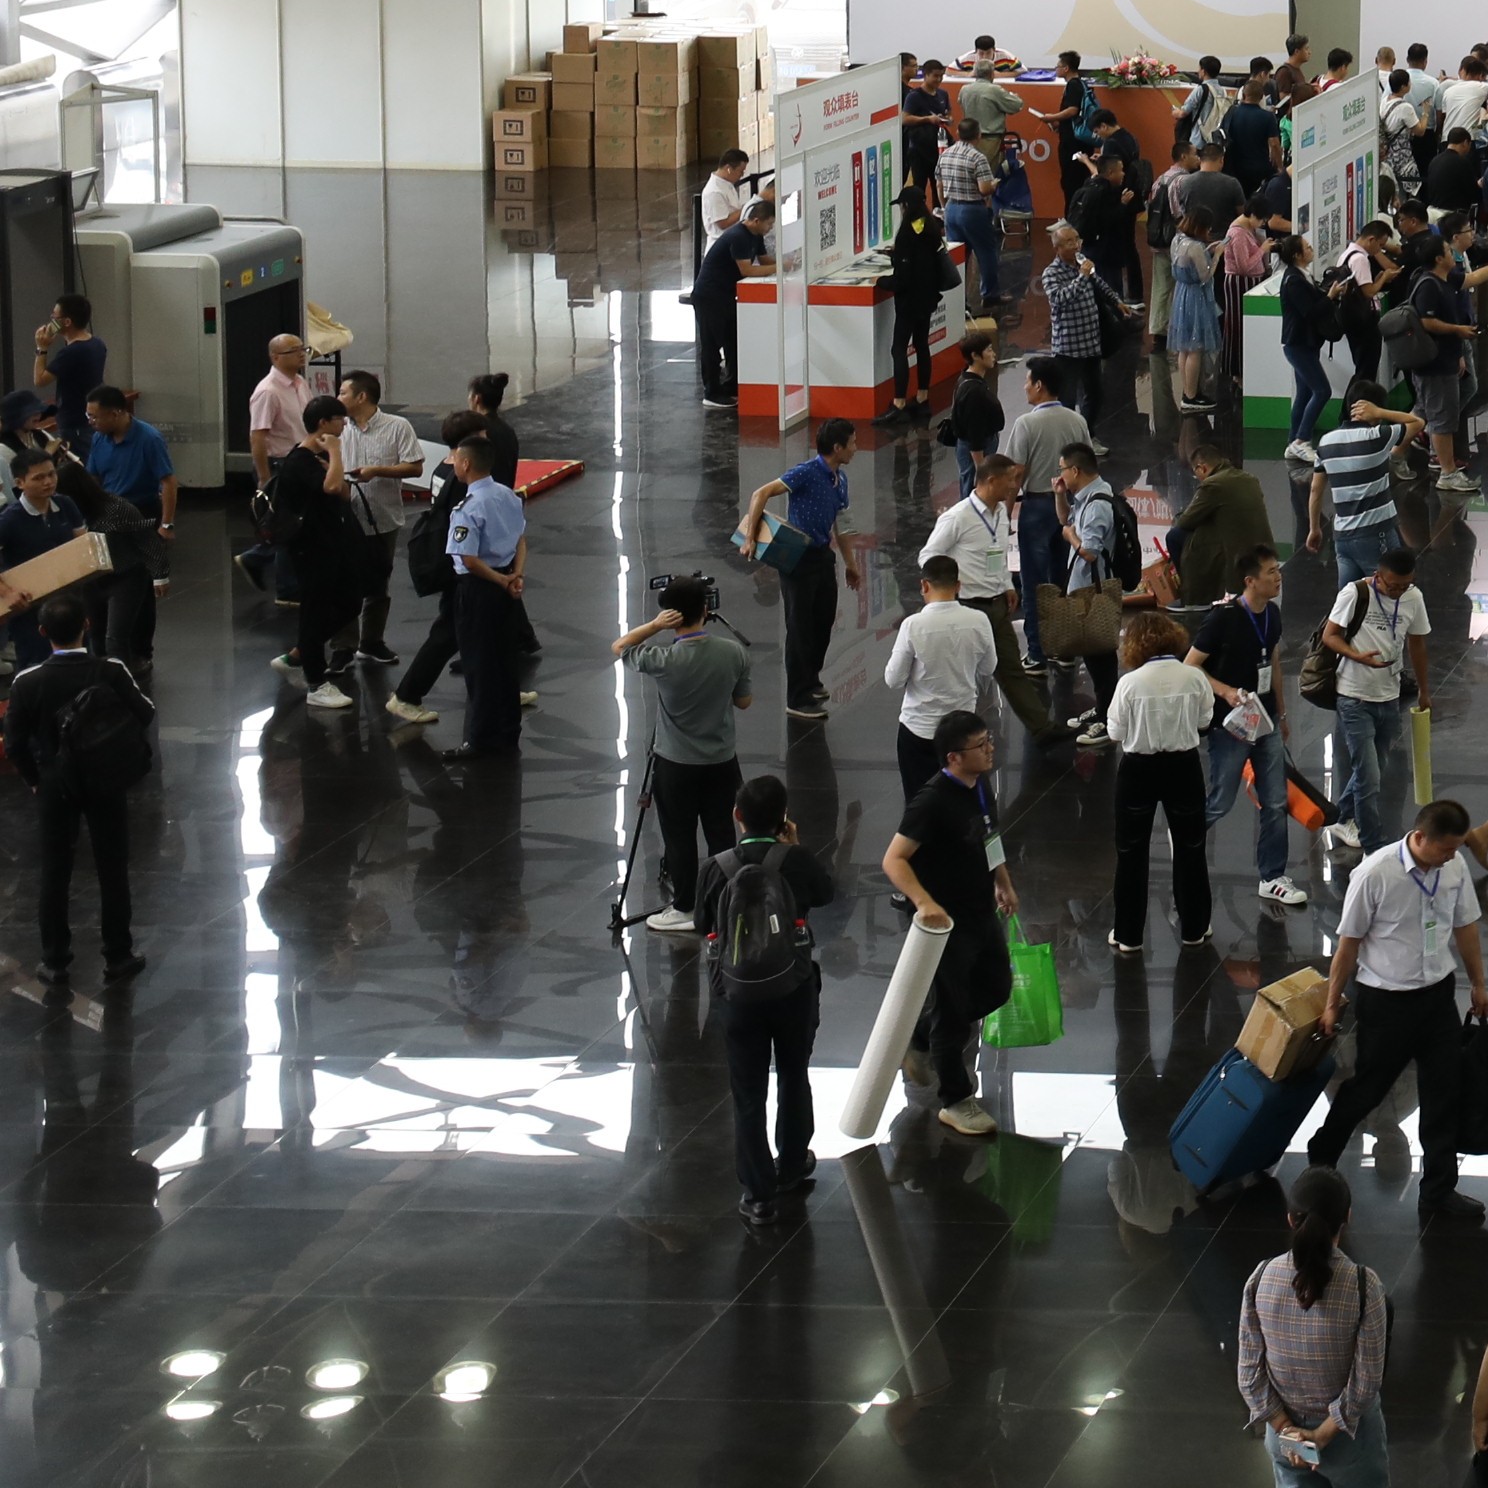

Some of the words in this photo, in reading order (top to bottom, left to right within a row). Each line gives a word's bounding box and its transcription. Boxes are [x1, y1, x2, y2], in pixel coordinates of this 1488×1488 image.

[823, 90, 859, 118] 观众填表台
[814, 163, 841, 188] 欢迎光临
[818, 184, 837, 201] WELCOME
